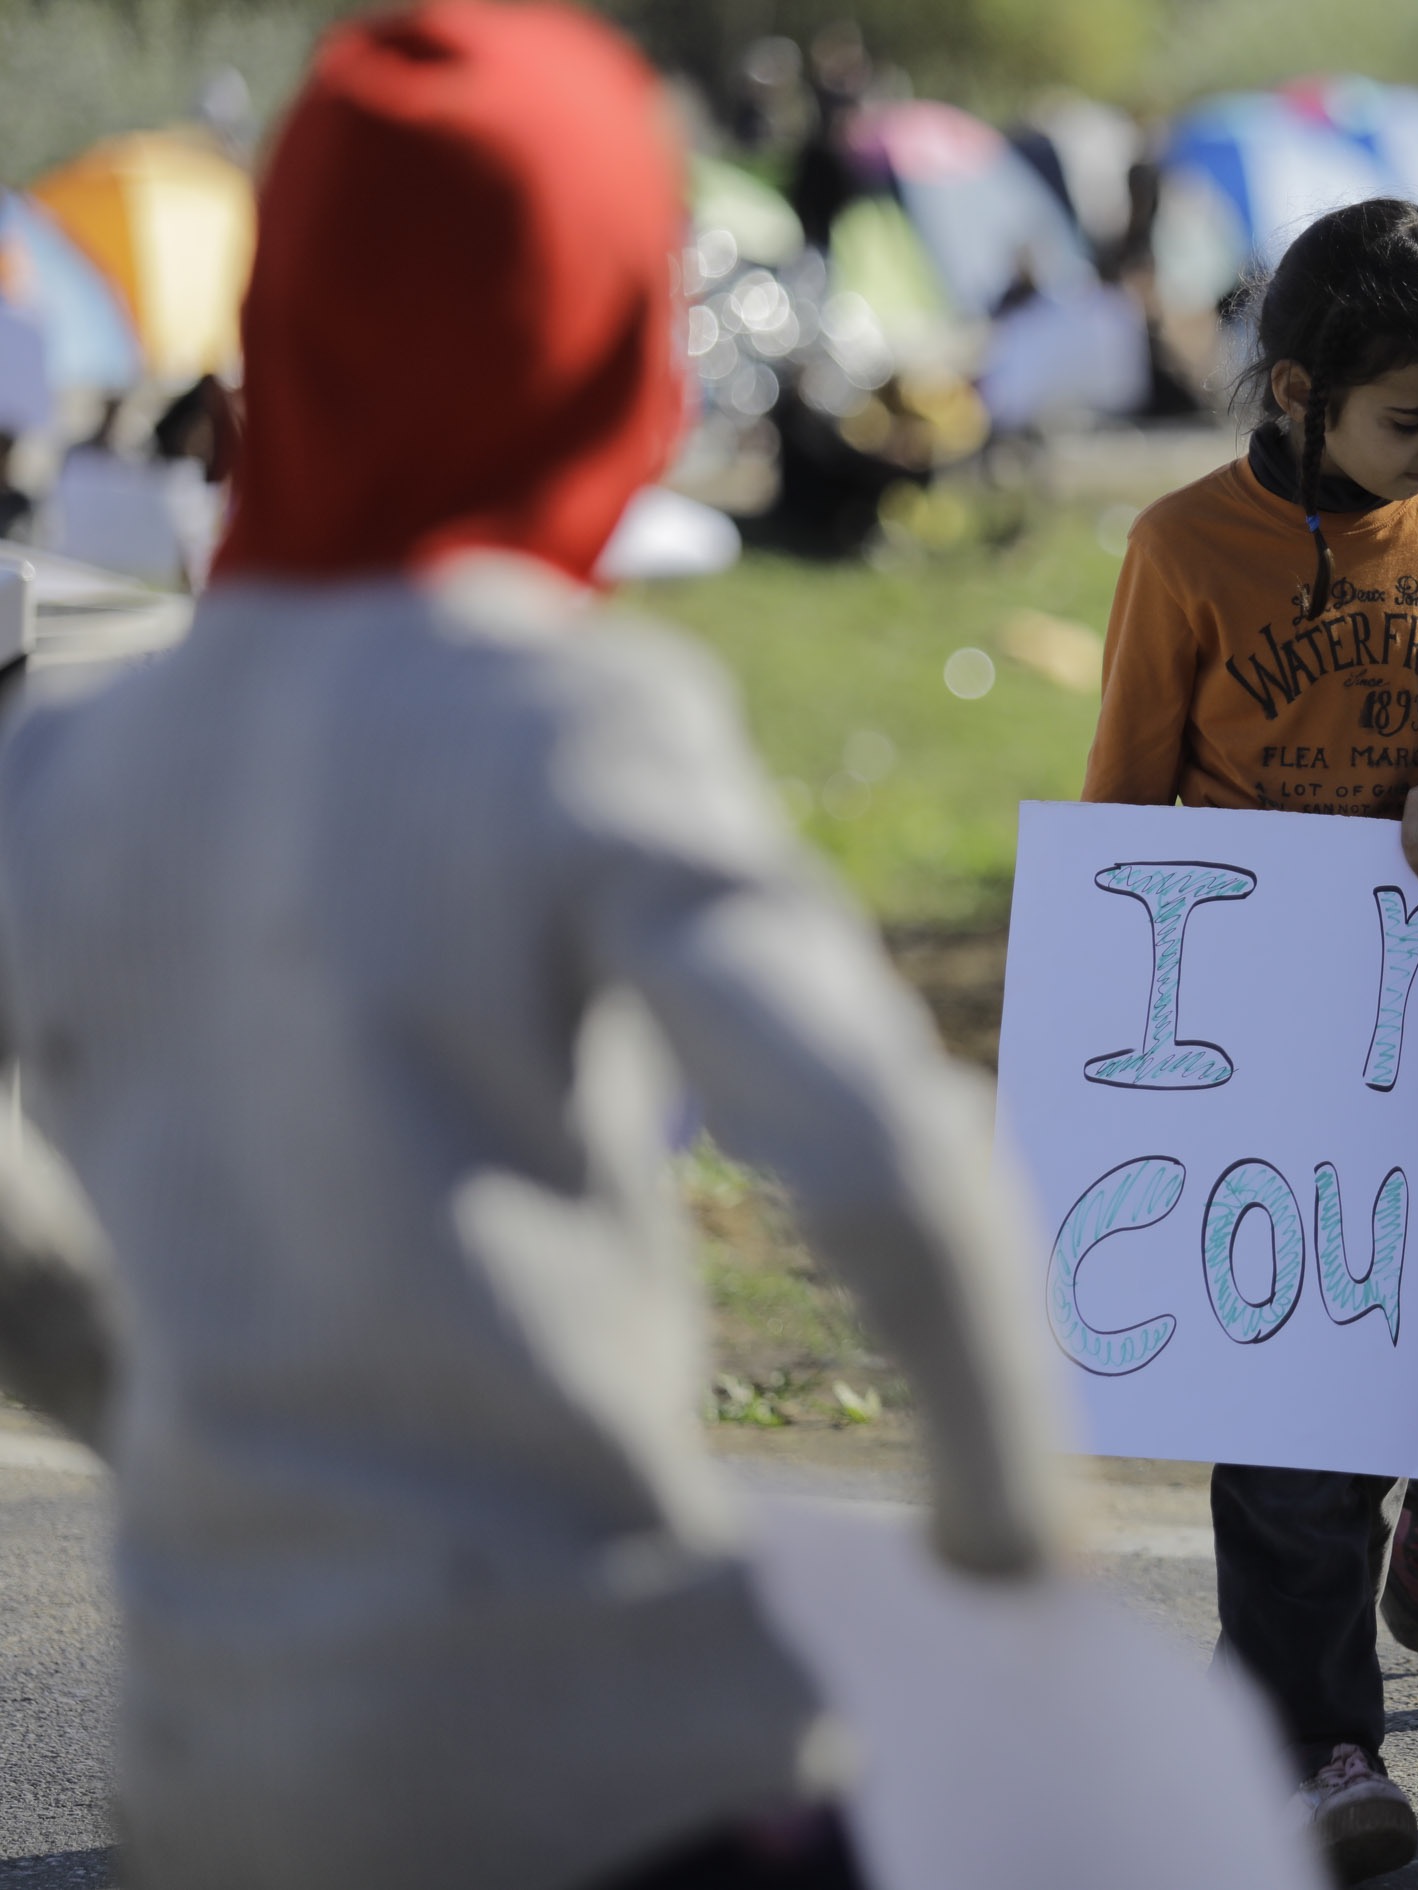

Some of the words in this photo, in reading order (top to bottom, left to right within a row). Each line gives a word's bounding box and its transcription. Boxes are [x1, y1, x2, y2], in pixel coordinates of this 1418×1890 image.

[1262, 746, 1329, 768] FLEA
[1281, 781, 1322, 798] LOT
[1335, 785, 1365, 798] OF
[1084, 861, 1258, 1091] I
